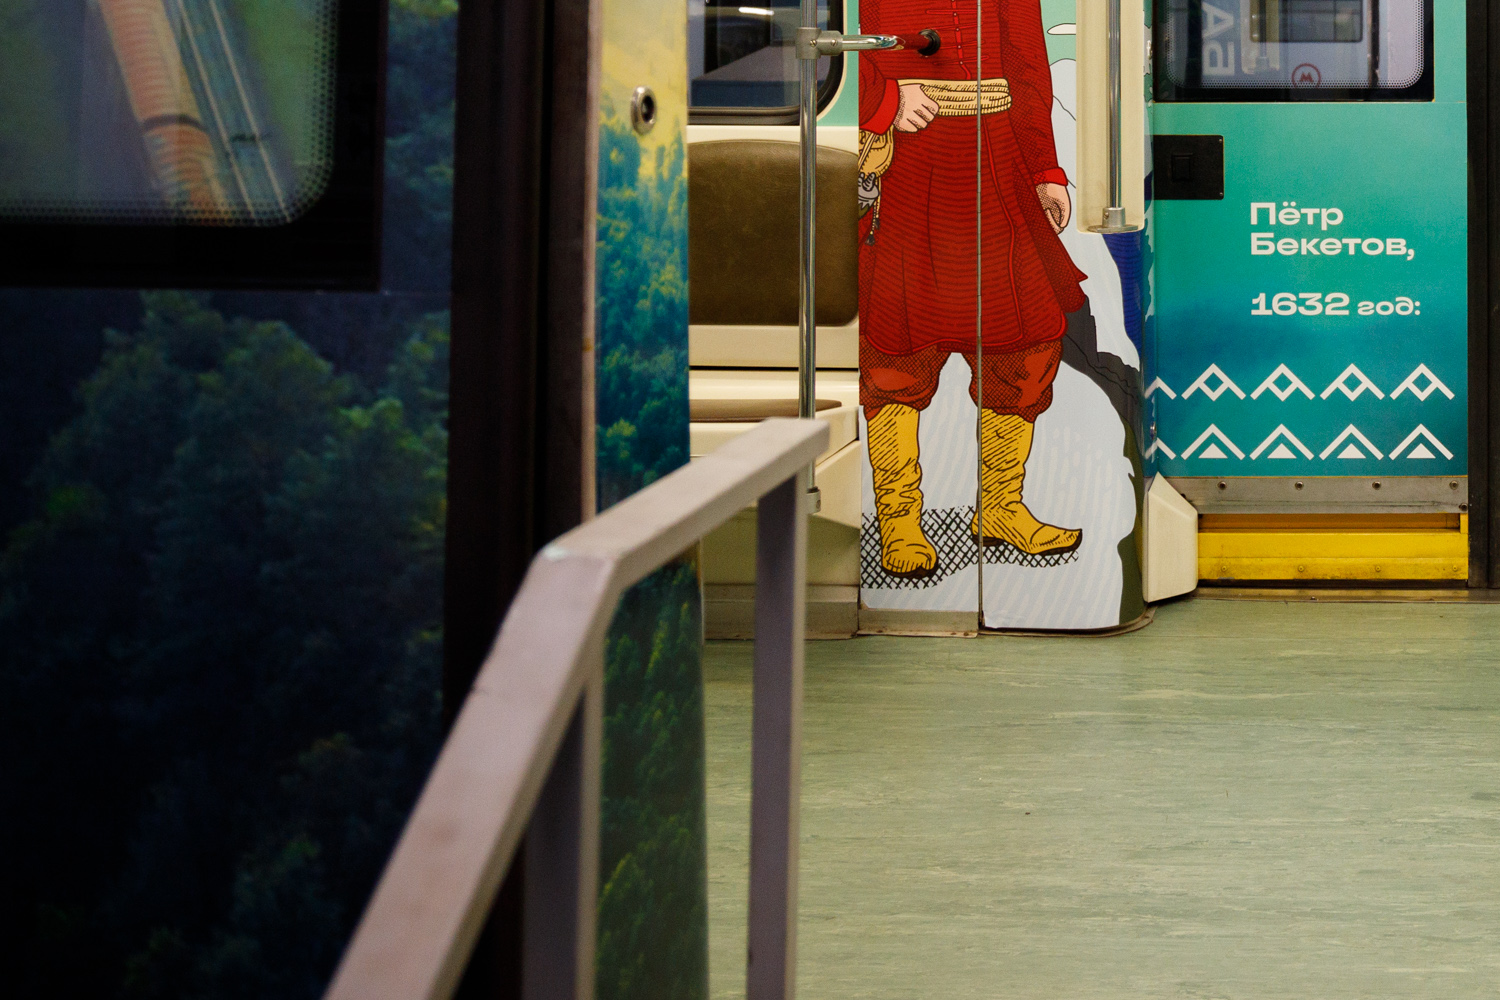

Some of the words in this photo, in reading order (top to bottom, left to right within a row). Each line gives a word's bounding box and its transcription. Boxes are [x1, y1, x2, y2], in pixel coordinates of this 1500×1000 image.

[1250, 201, 1344, 231] Пётр
[1250, 232, 1415, 261] Бекетов,
[1251, 292, 1350, 316] 1632
[1357, 296, 1421, 316] год:
